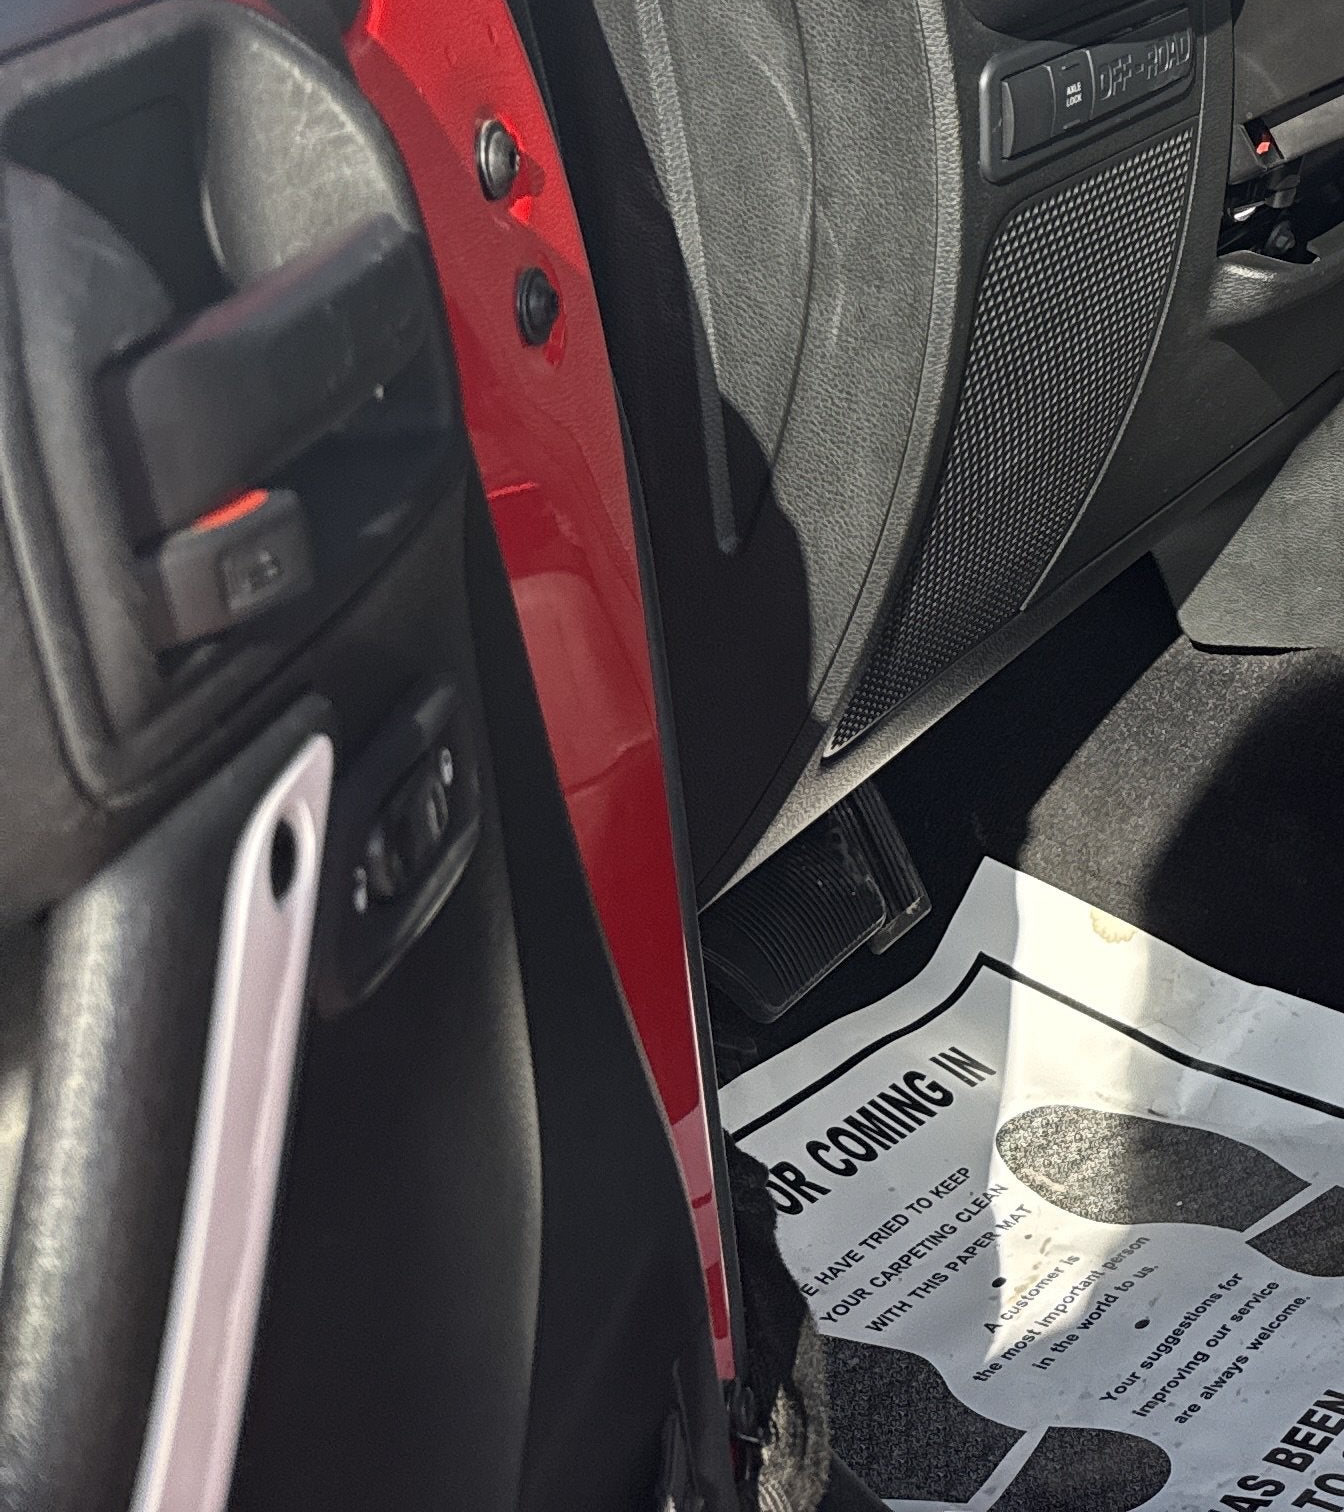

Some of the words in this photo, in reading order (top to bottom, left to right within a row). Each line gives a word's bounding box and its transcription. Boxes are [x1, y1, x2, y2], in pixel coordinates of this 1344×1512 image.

[1066, 82, 1082, 95] AXLE
[1066, 93, 1082, 108] LOCK
[805, 1070, 954, 1177] COMING
[929, 1046, 997, 1088] IN
[814, 1249, 865, 1285] HAVE
[859, 1213, 910, 1250] TRIED
[905, 1197, 933, 1214] TO
[930, 1167, 970, 1199] KEEP
[819, 1287, 873, 1324] YOUR
[869, 1223, 958, 1288] CARPETING
[955, 1183, 1009, 1223] CLEAN
[865, 1300, 913, 1332] WITH
[907, 1272, 949, 1299] THIS
[945, 1231, 1000, 1272] PAPER
[994, 1204, 1033, 1230] MAT
[972, 1360, 1003, 1382] the
[1001, 1327, 1043, 1361] most
[1037, 1269, 1105, 1328] important
[1102, 1236, 1151, 1271] person
[983, 1321, 1003, 1334] A
[1000, 1265, 1065, 1322] customer
[1032, 1354, 1056, 1371] in
[1050, 1330, 1081, 1356] the
[1077, 1291, 1119, 1331] world
[1115, 1278, 1135, 1294] to
[1132, 1263, 1159, 1280] us.
[1100, 1370, 1141, 1403] Your
[1139, 1292, 1223, 1370] suggestions
[1217, 1272, 1244, 1292] for
[1132, 1350, 1210, 1418] improving
[1206, 1323, 1232, 1348] our
[1230, 1281, 1280, 1323] service
[1174, 1402, 1202, 1425] are
[1199, 1353, 1249, 1401] always
[1245, 1294, 1311, 1352] welcome.
[1208, 1474, 1286, 1512] AS
